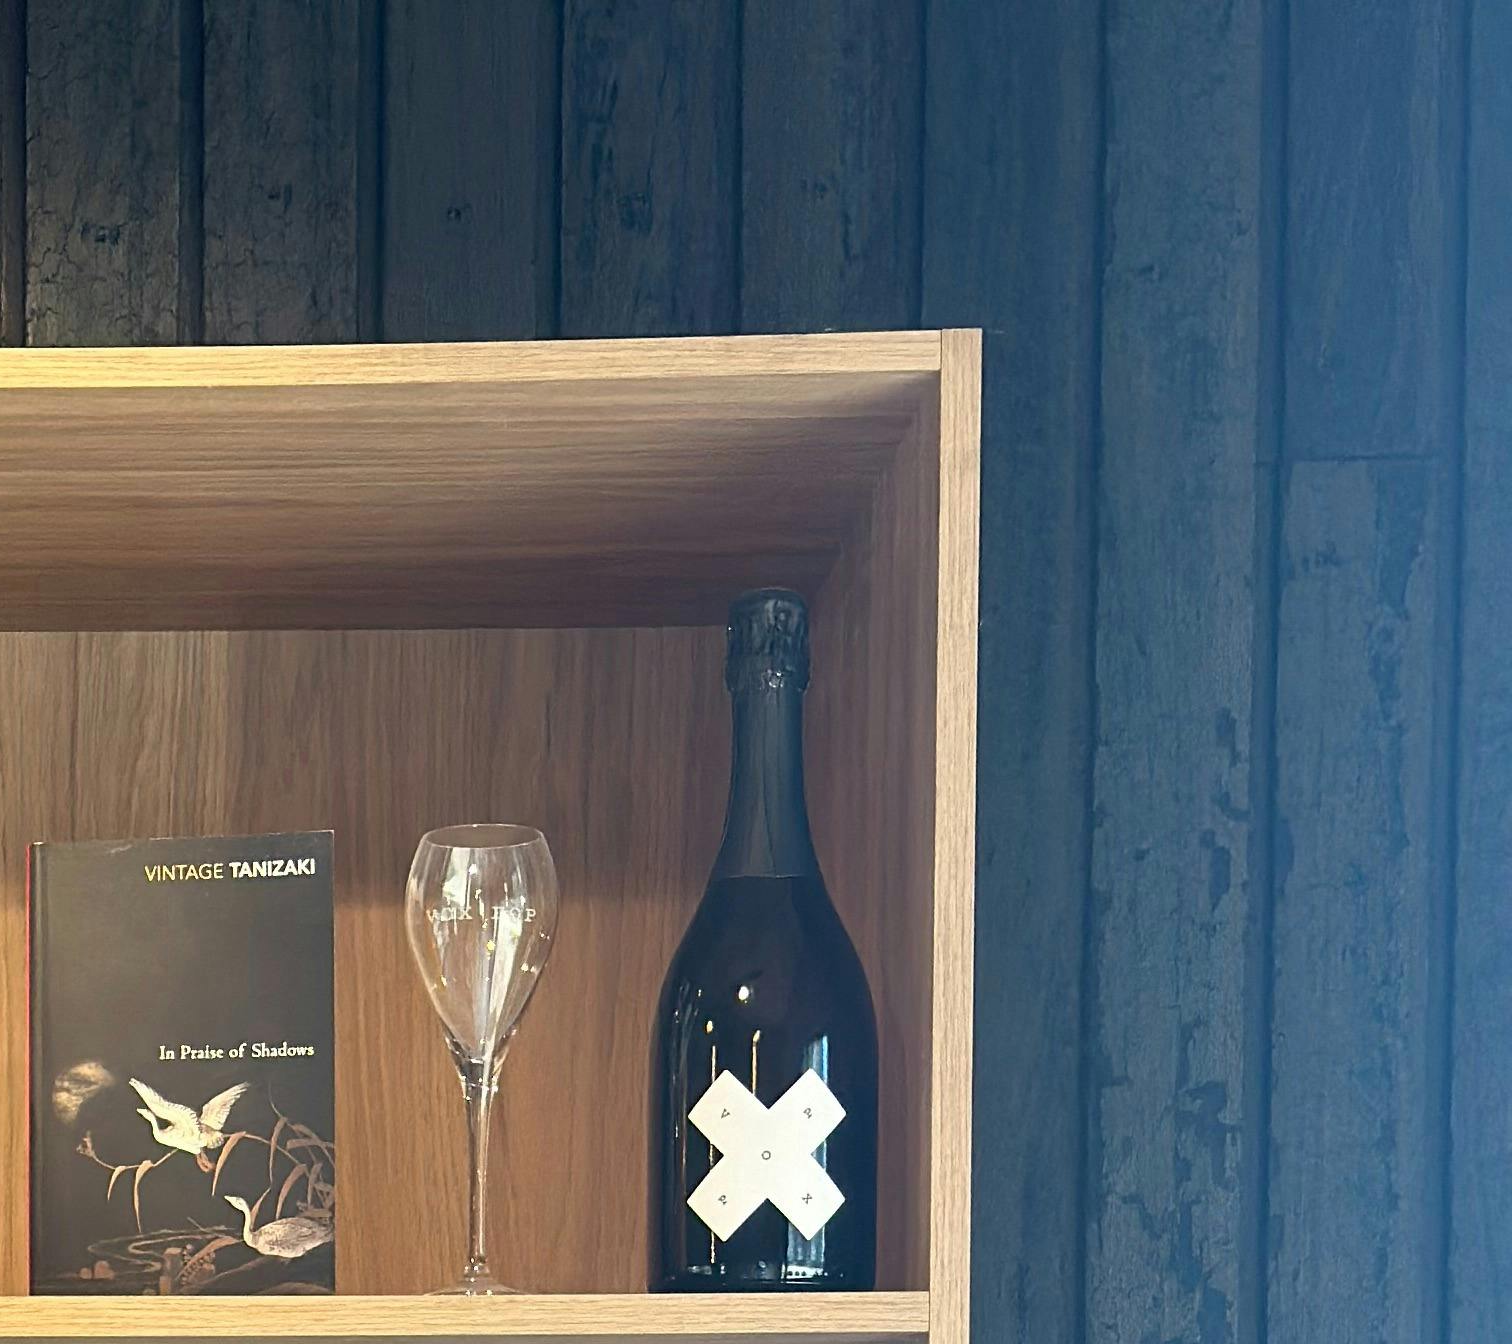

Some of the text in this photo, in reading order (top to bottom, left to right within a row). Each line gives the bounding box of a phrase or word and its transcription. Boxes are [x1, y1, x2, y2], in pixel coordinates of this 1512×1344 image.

[145, 858, 316, 882] VINTAGE TANIZAKI
[159, 1041, 315, 1060] In Praise of Shadows
